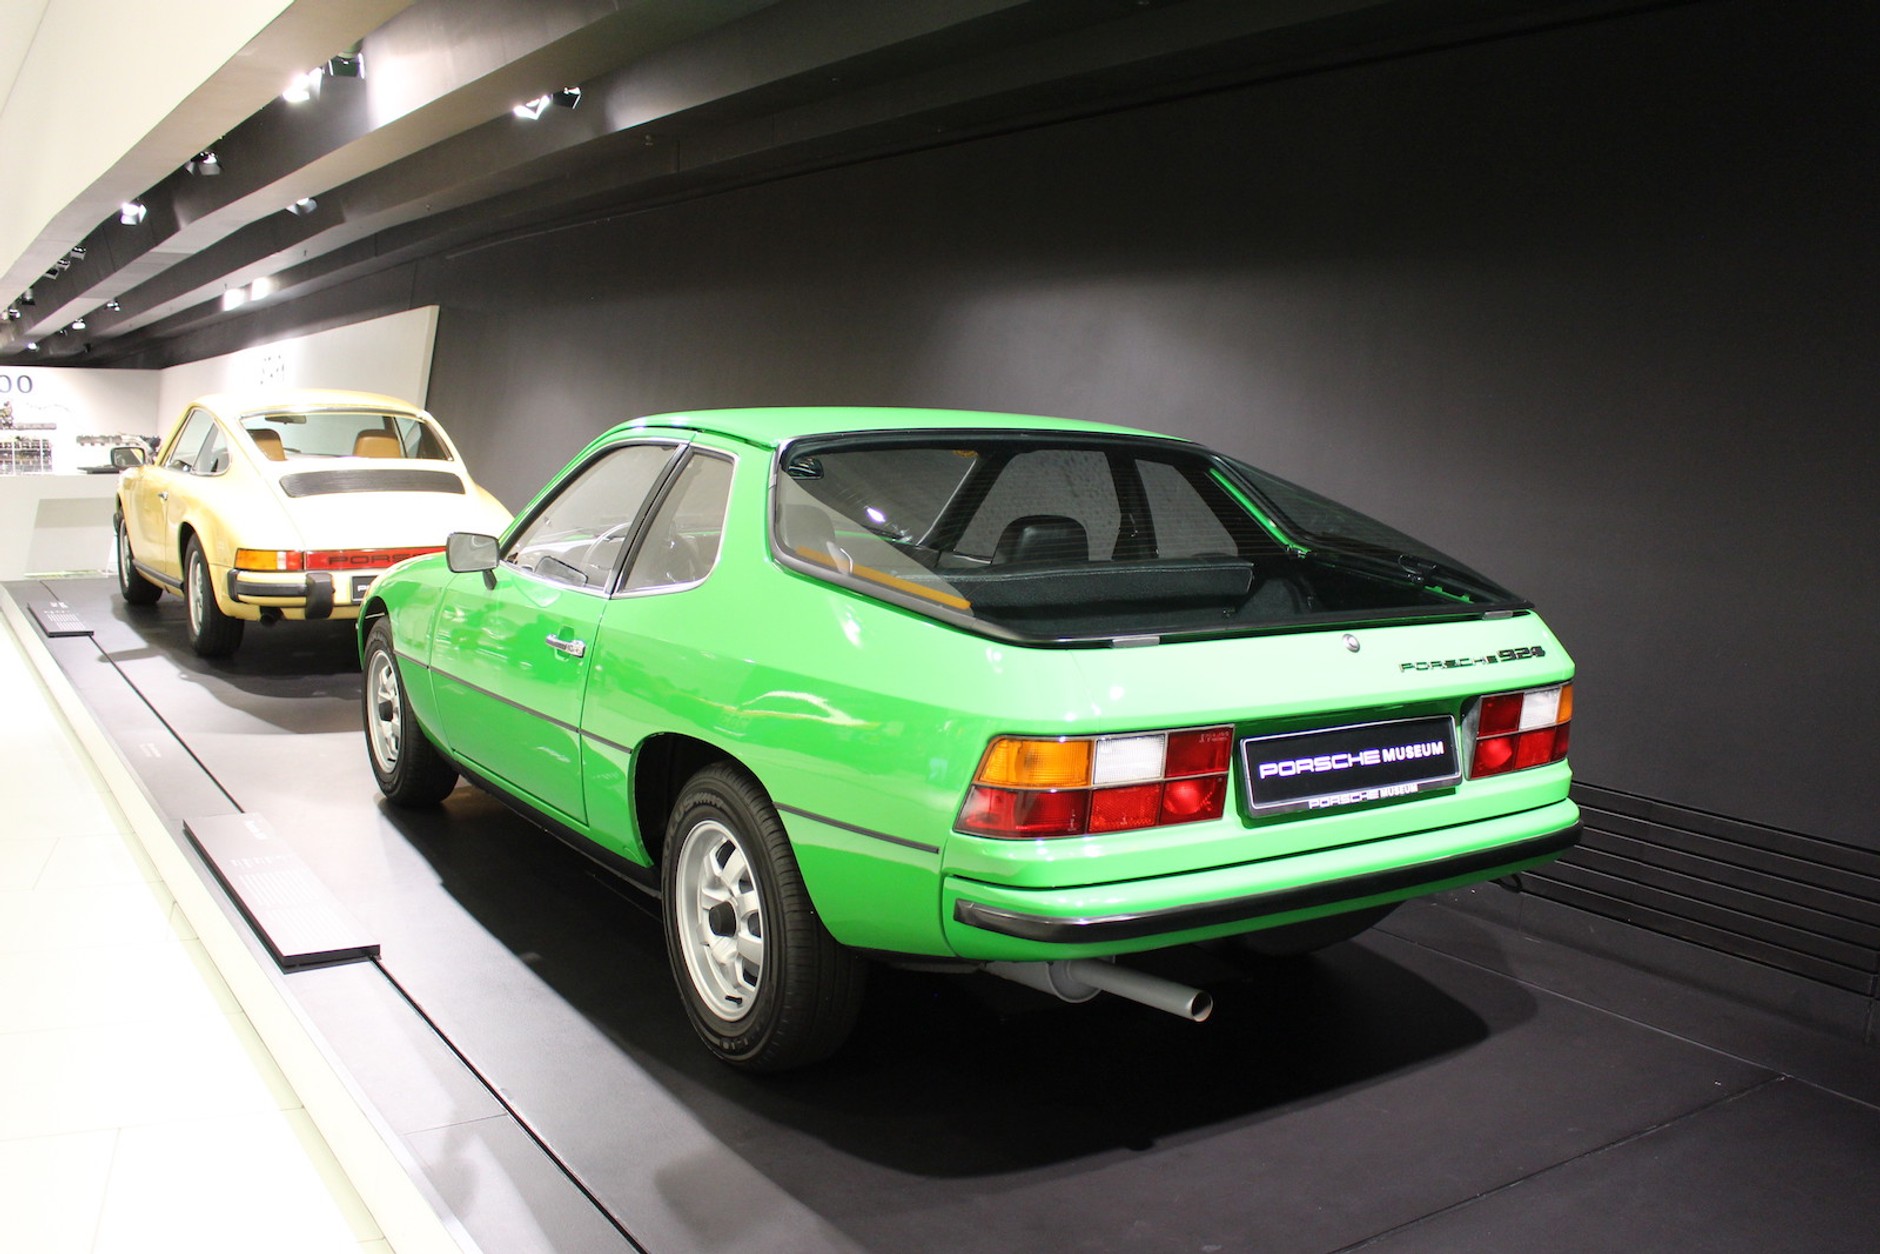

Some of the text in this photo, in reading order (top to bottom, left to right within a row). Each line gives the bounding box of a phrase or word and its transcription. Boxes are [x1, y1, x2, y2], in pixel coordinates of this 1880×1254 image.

[1399, 645, 1546, 673] PORSCHE 924
[1258, 740, 1445, 780] PORSCHE MUSEUM
[1308, 782, 1419, 809] PORSCHE MUSEUM
